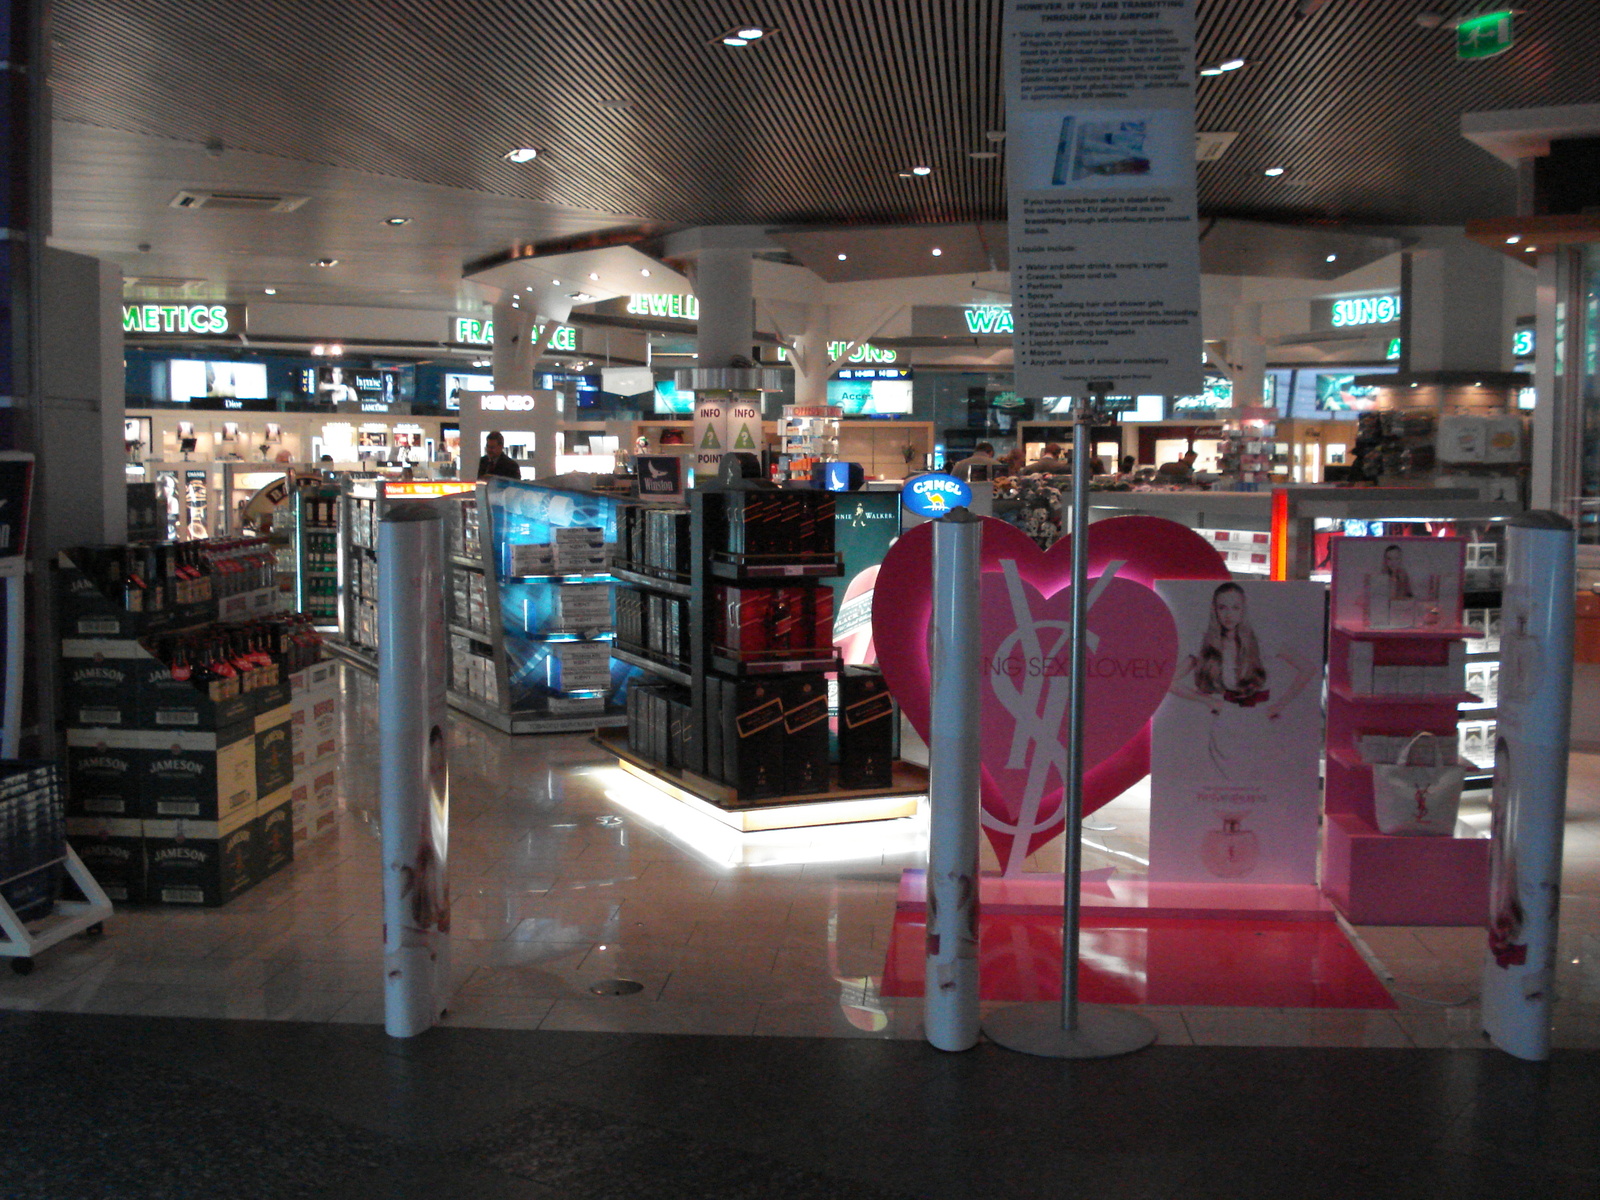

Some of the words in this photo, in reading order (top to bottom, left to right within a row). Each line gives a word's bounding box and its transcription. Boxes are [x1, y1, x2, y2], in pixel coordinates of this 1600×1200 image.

[964, 310, 1014, 334] WA
[481, 395, 535, 411] KENZO
[700, 408, 720, 418] INFO
[734, 408, 755, 418] INFO
[698, 454, 722, 464] POINT
[644, 477, 673, 491] Winston
[913, 480, 962, 496] CAMEL
[72, 667, 126, 682] JAMESON
[984, 657, 1022, 677] NG
[1029, 657, 1068, 677] SEX
[1087, 656, 1168, 679] LOVELY
[78, 756, 129, 772] JAMESON
[150, 759, 204, 775] JAMESON
[154, 847, 208, 863] JAMESON
